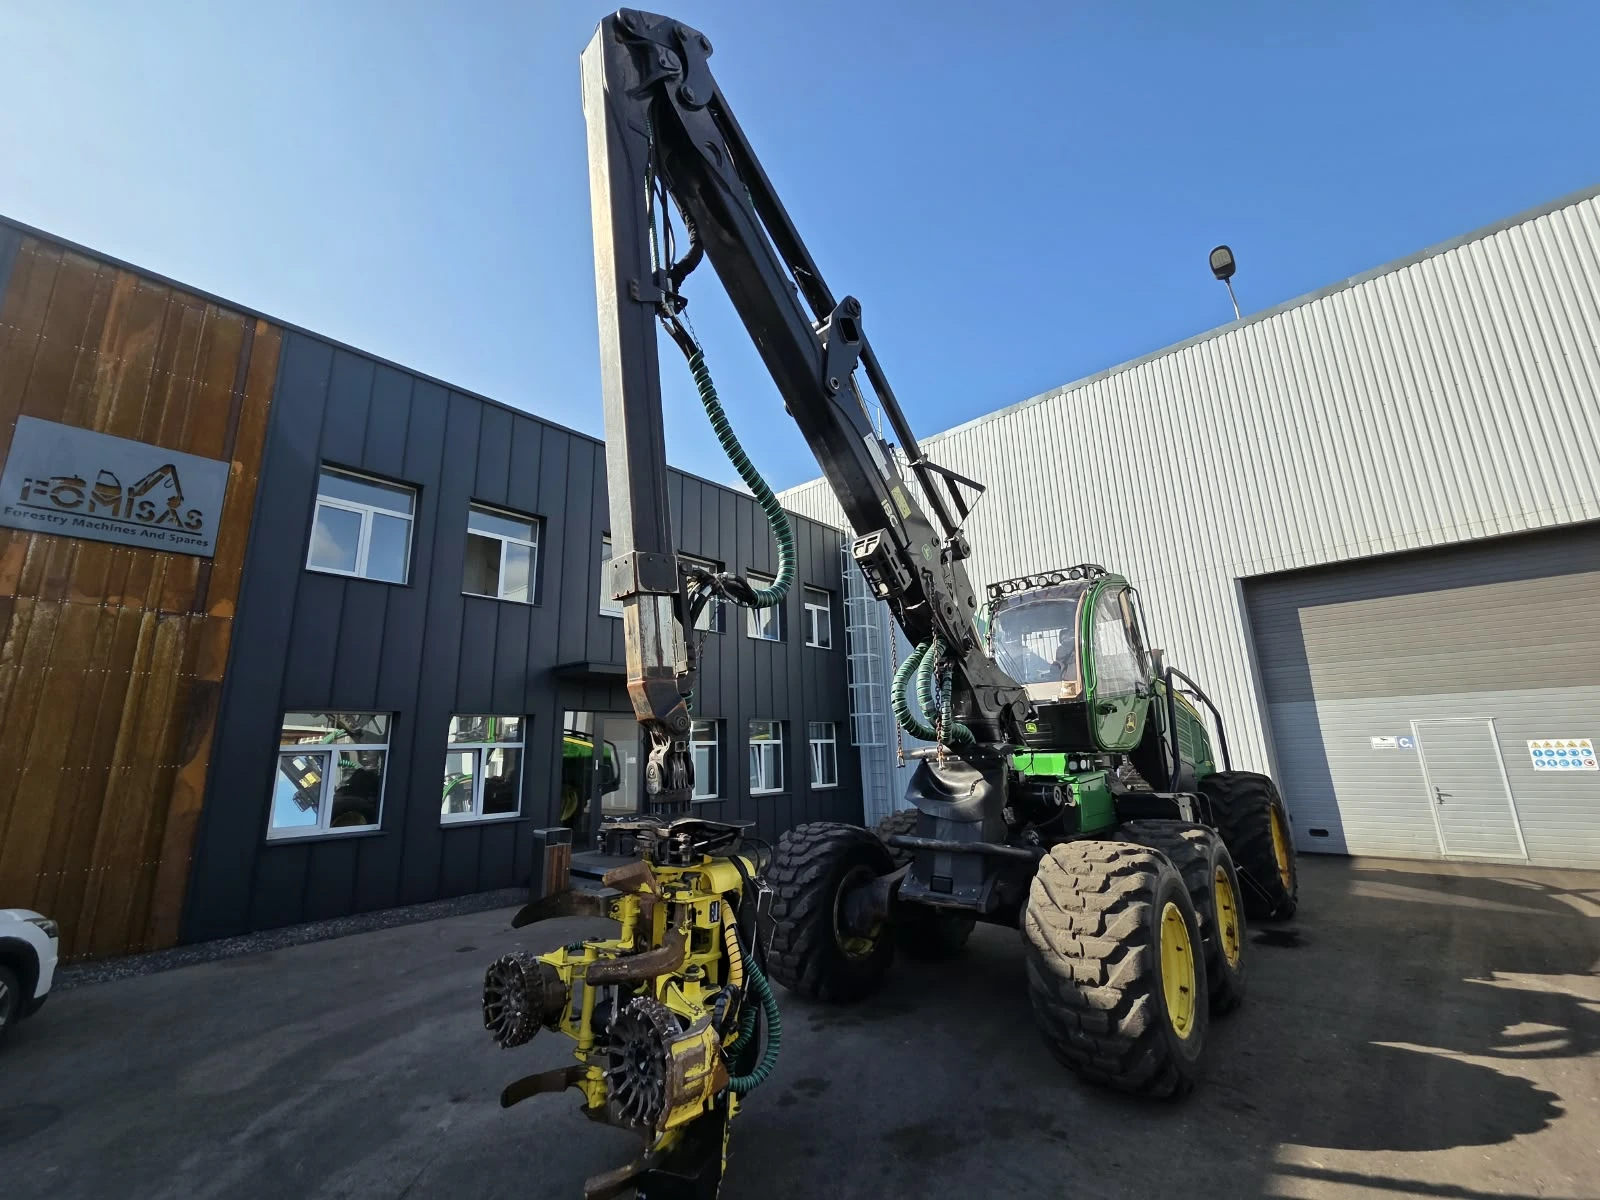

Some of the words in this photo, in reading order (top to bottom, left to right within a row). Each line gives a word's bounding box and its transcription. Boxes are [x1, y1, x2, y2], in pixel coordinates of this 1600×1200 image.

[4, 507, 68, 525] Forestry
[72, 518, 136, 535] Machines
[140, 529, 165, 540] And
[169, 534, 209, 547] Spares
